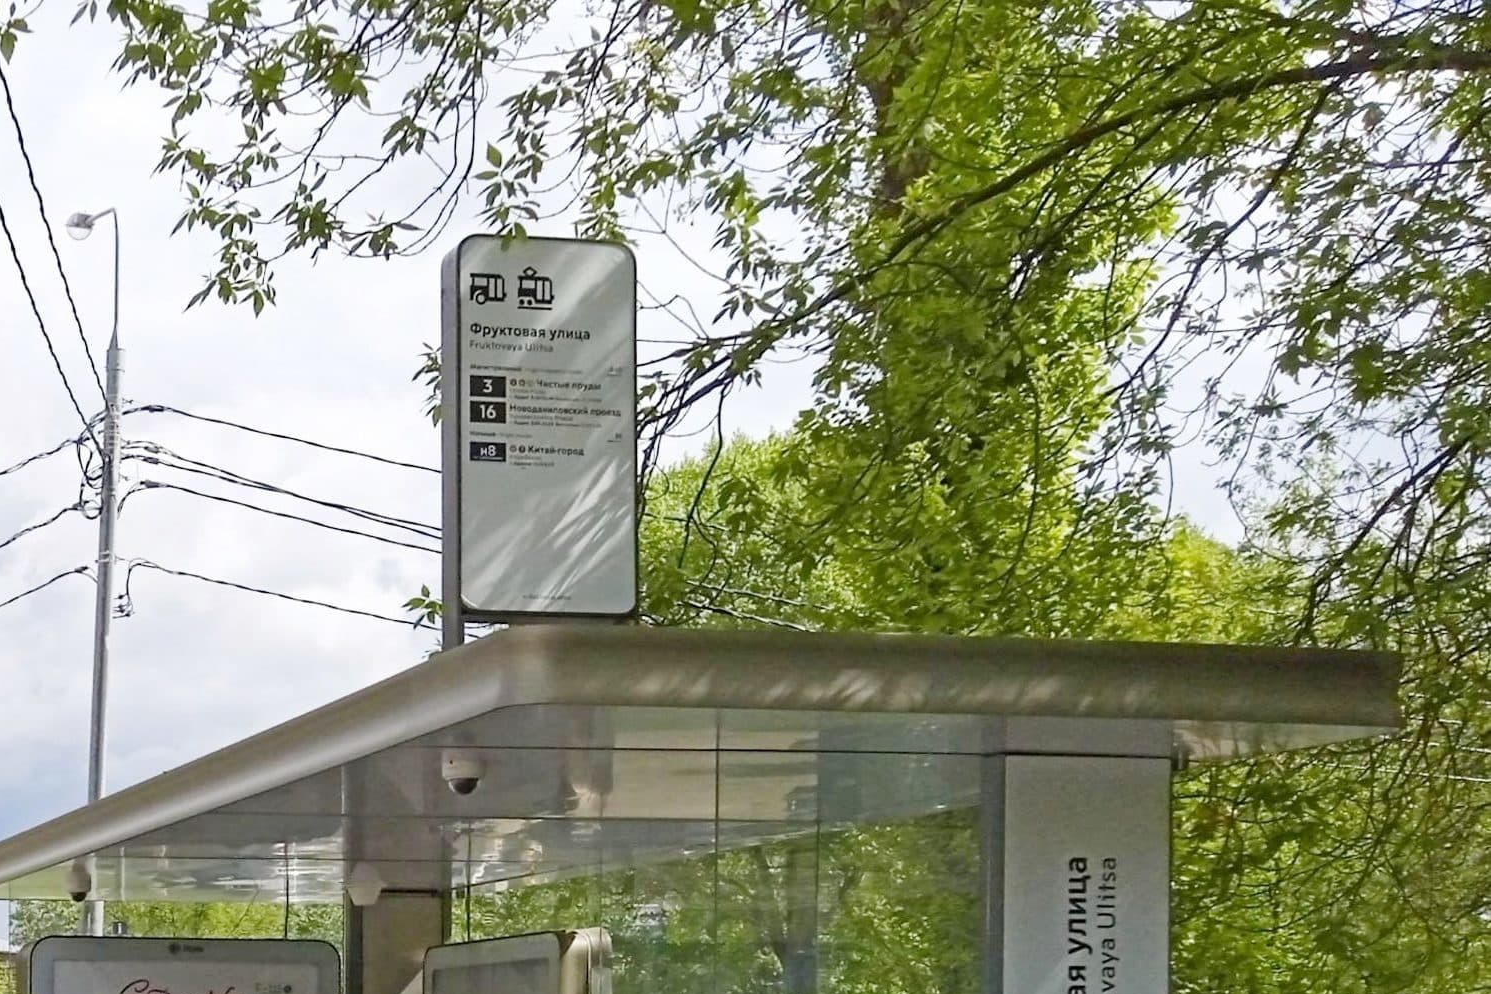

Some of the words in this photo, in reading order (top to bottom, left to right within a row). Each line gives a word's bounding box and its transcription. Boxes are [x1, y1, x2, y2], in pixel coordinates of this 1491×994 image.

[469, 322, 546, 338] Фруктовая
[549, 328, 591, 341] улица
[469, 340, 523, 352] Fruktovaya
[525, 343, 554, 353] Ulitsa
[482, 379, 493, 393] 3
[479, 404, 497, 419] 16
[527, 445, 585, 457] Китай-город
[1096, 857, 1117, 930] Ulitsa
[1067, 856, 1093, 956] улица
